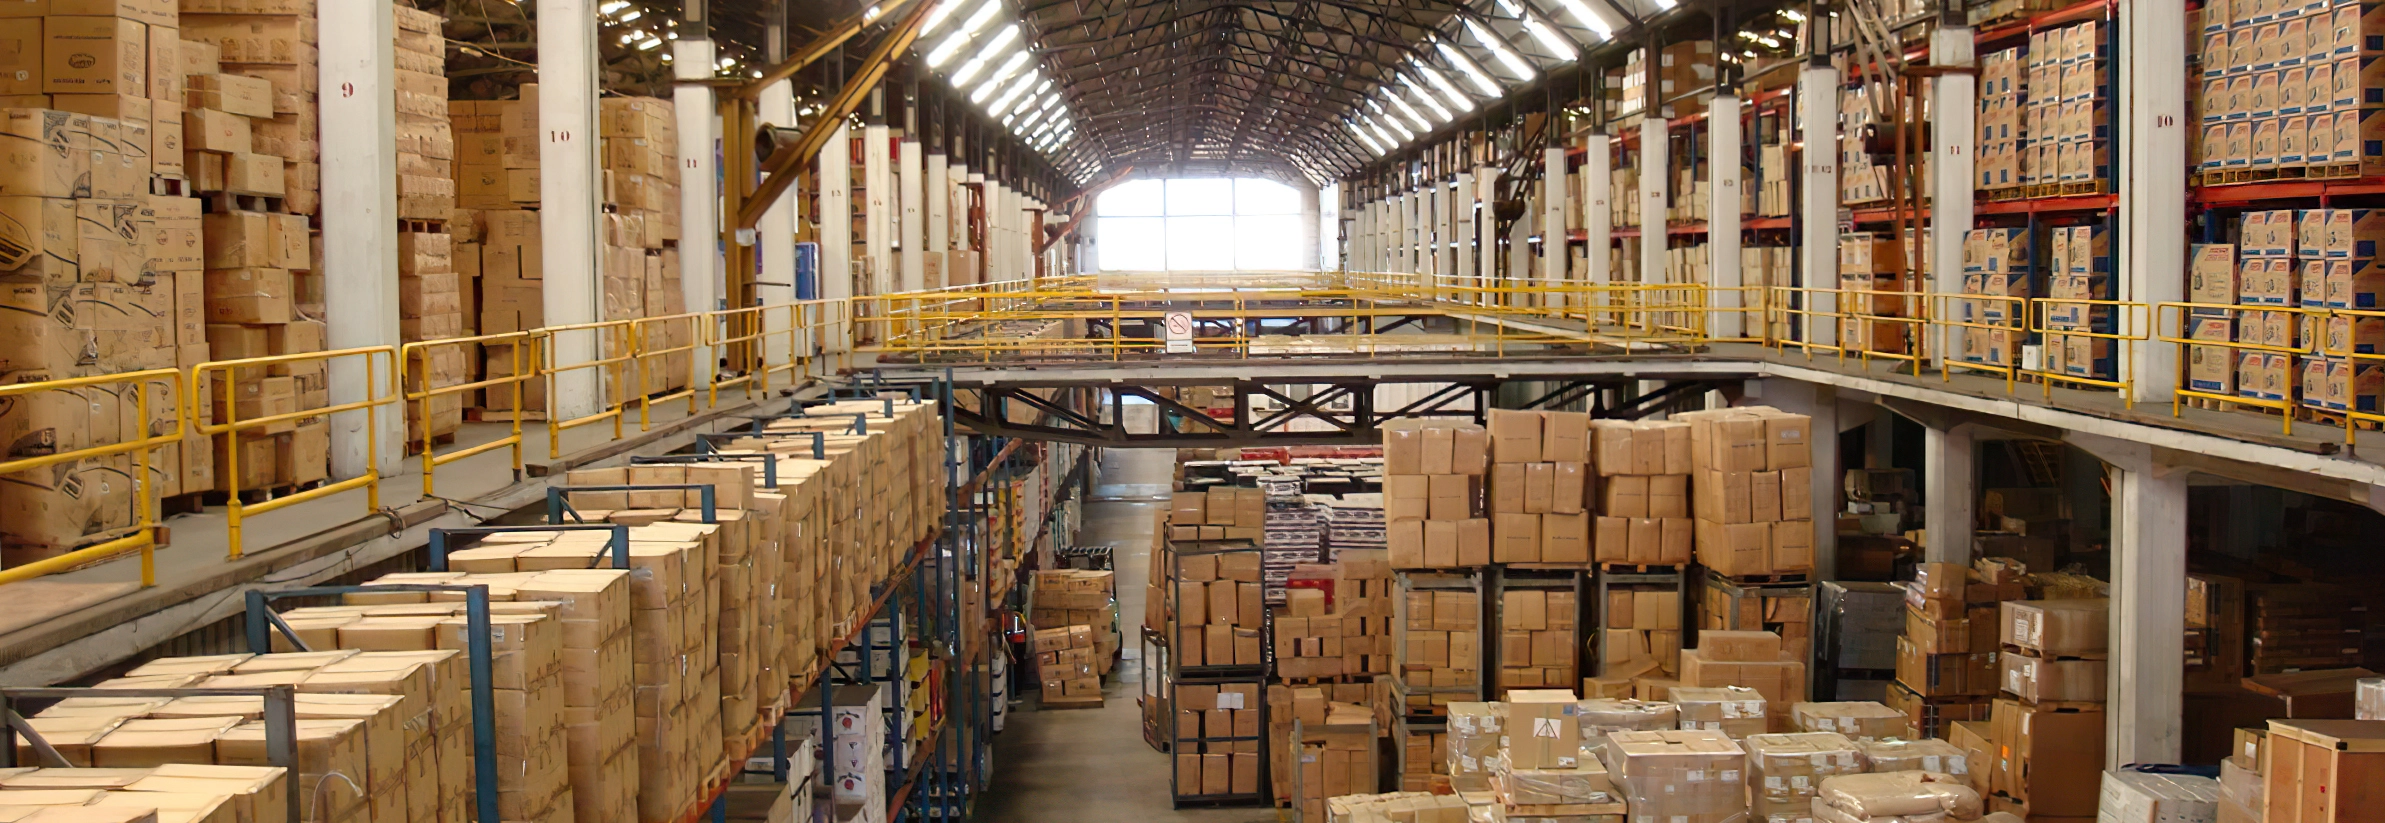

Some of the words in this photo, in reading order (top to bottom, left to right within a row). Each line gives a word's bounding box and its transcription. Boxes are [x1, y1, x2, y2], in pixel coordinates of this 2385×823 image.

[341, 82, 354, 98] 9
[2157, 115, 2174, 128] 10
[551, 130, 570, 143] 10
[687, 158, 697, 168] 11
